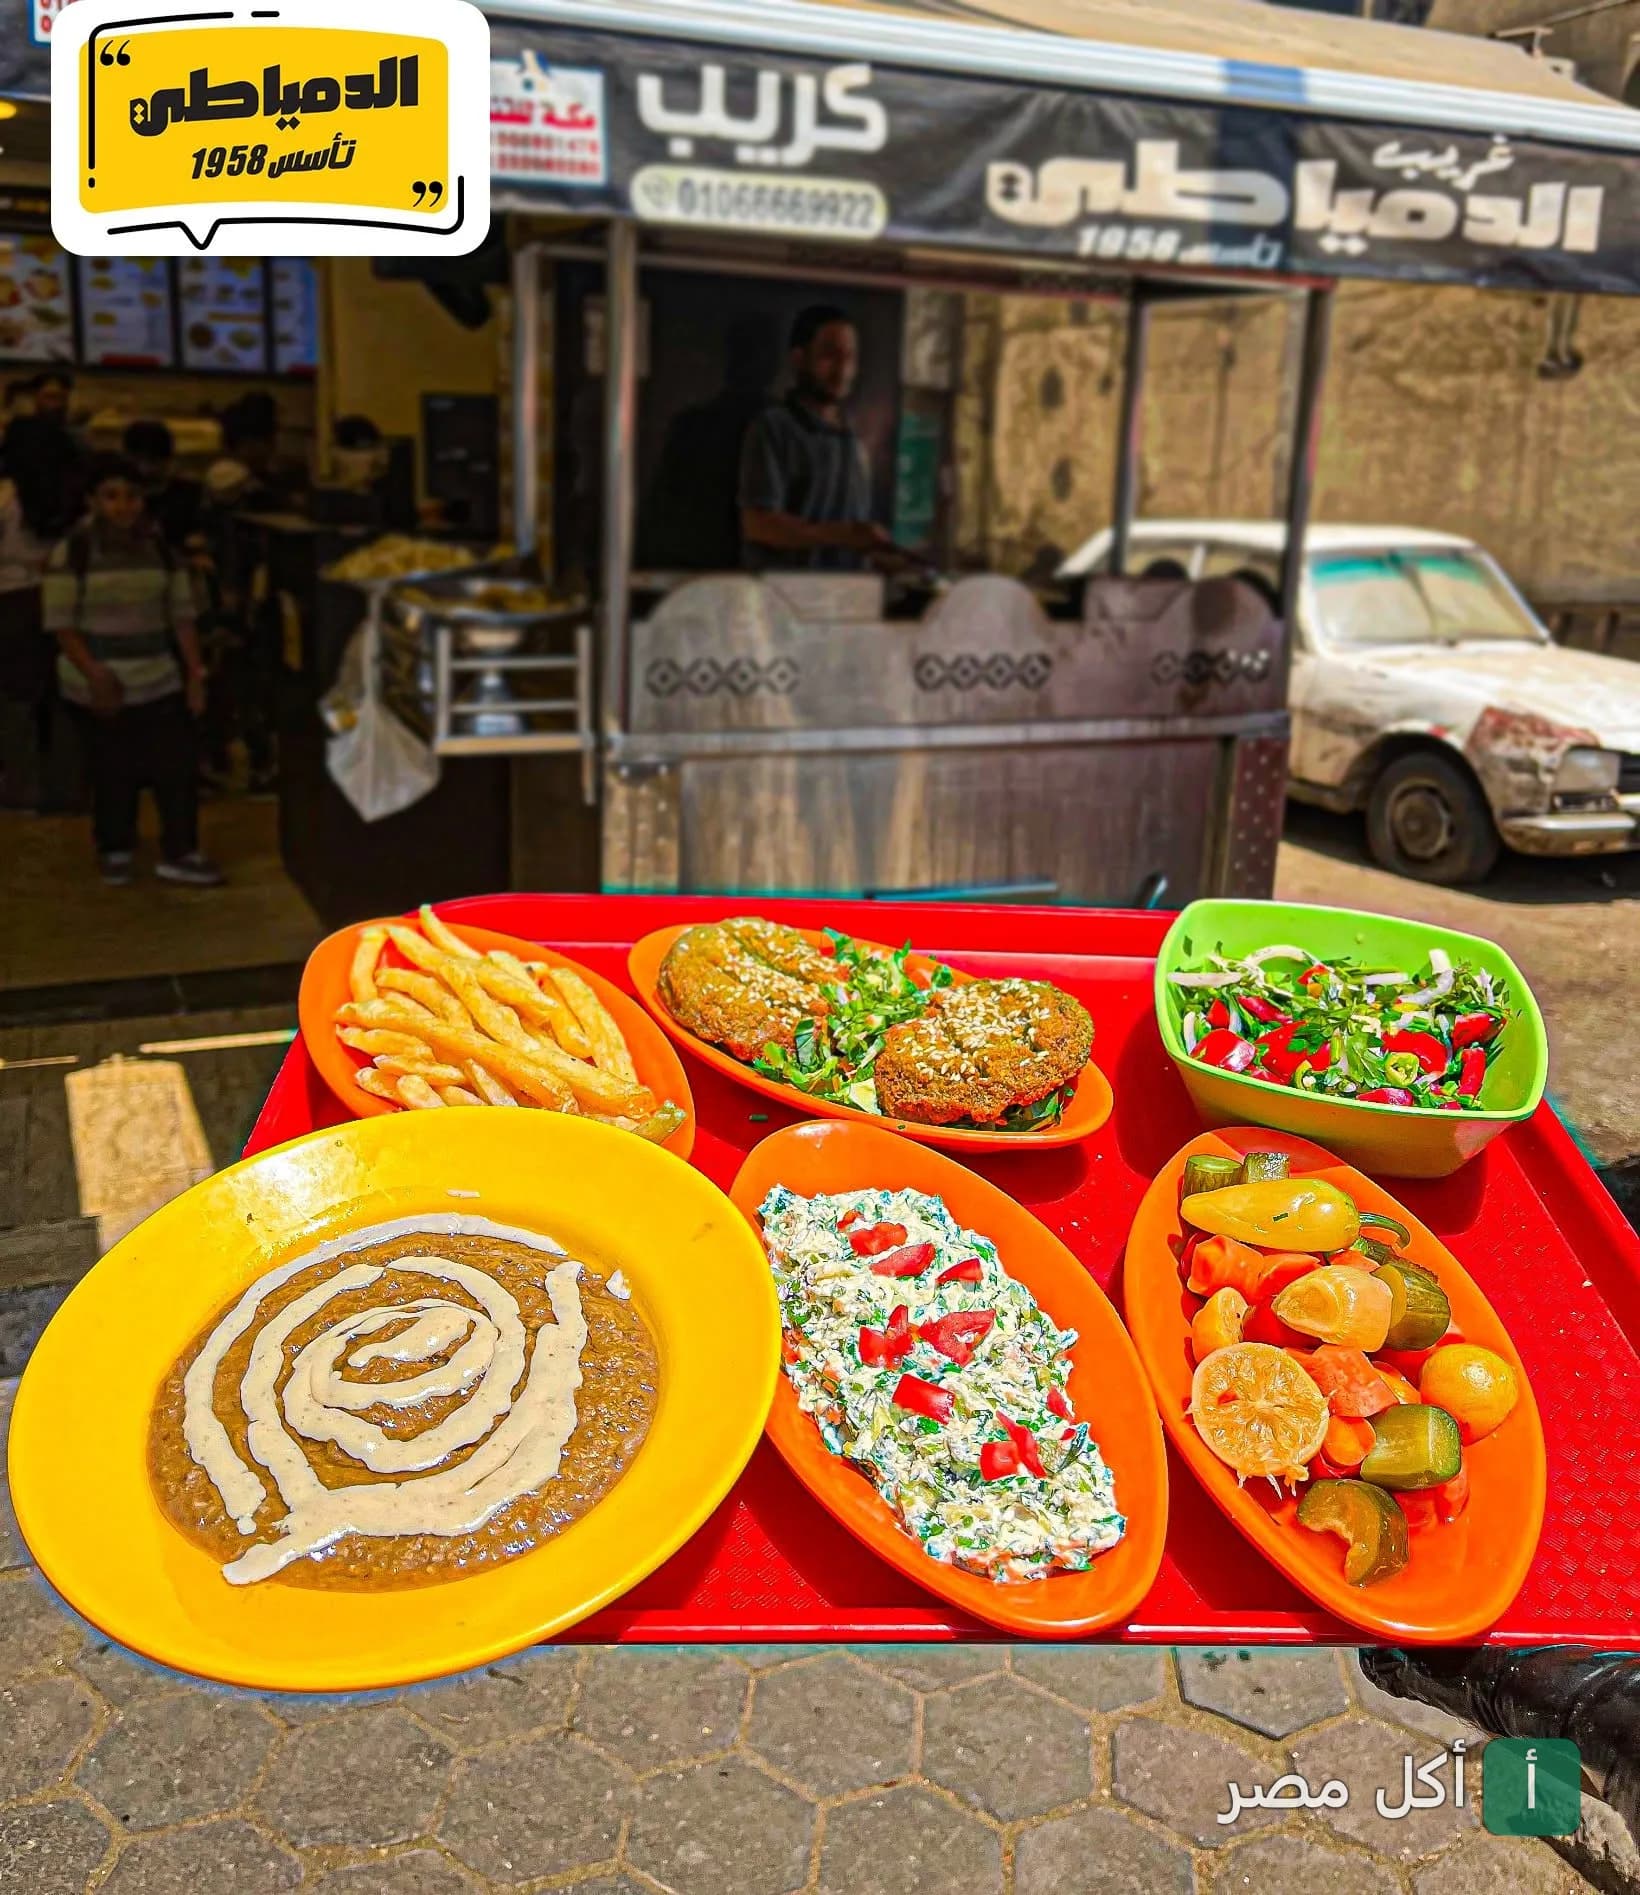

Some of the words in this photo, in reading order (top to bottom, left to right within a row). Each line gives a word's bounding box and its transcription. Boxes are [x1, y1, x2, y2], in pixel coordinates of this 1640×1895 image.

[636, 64, 888, 166] كريب
[1371, 134, 1514, 190] غريب
[1078, 226, 1179, 261] 1958
